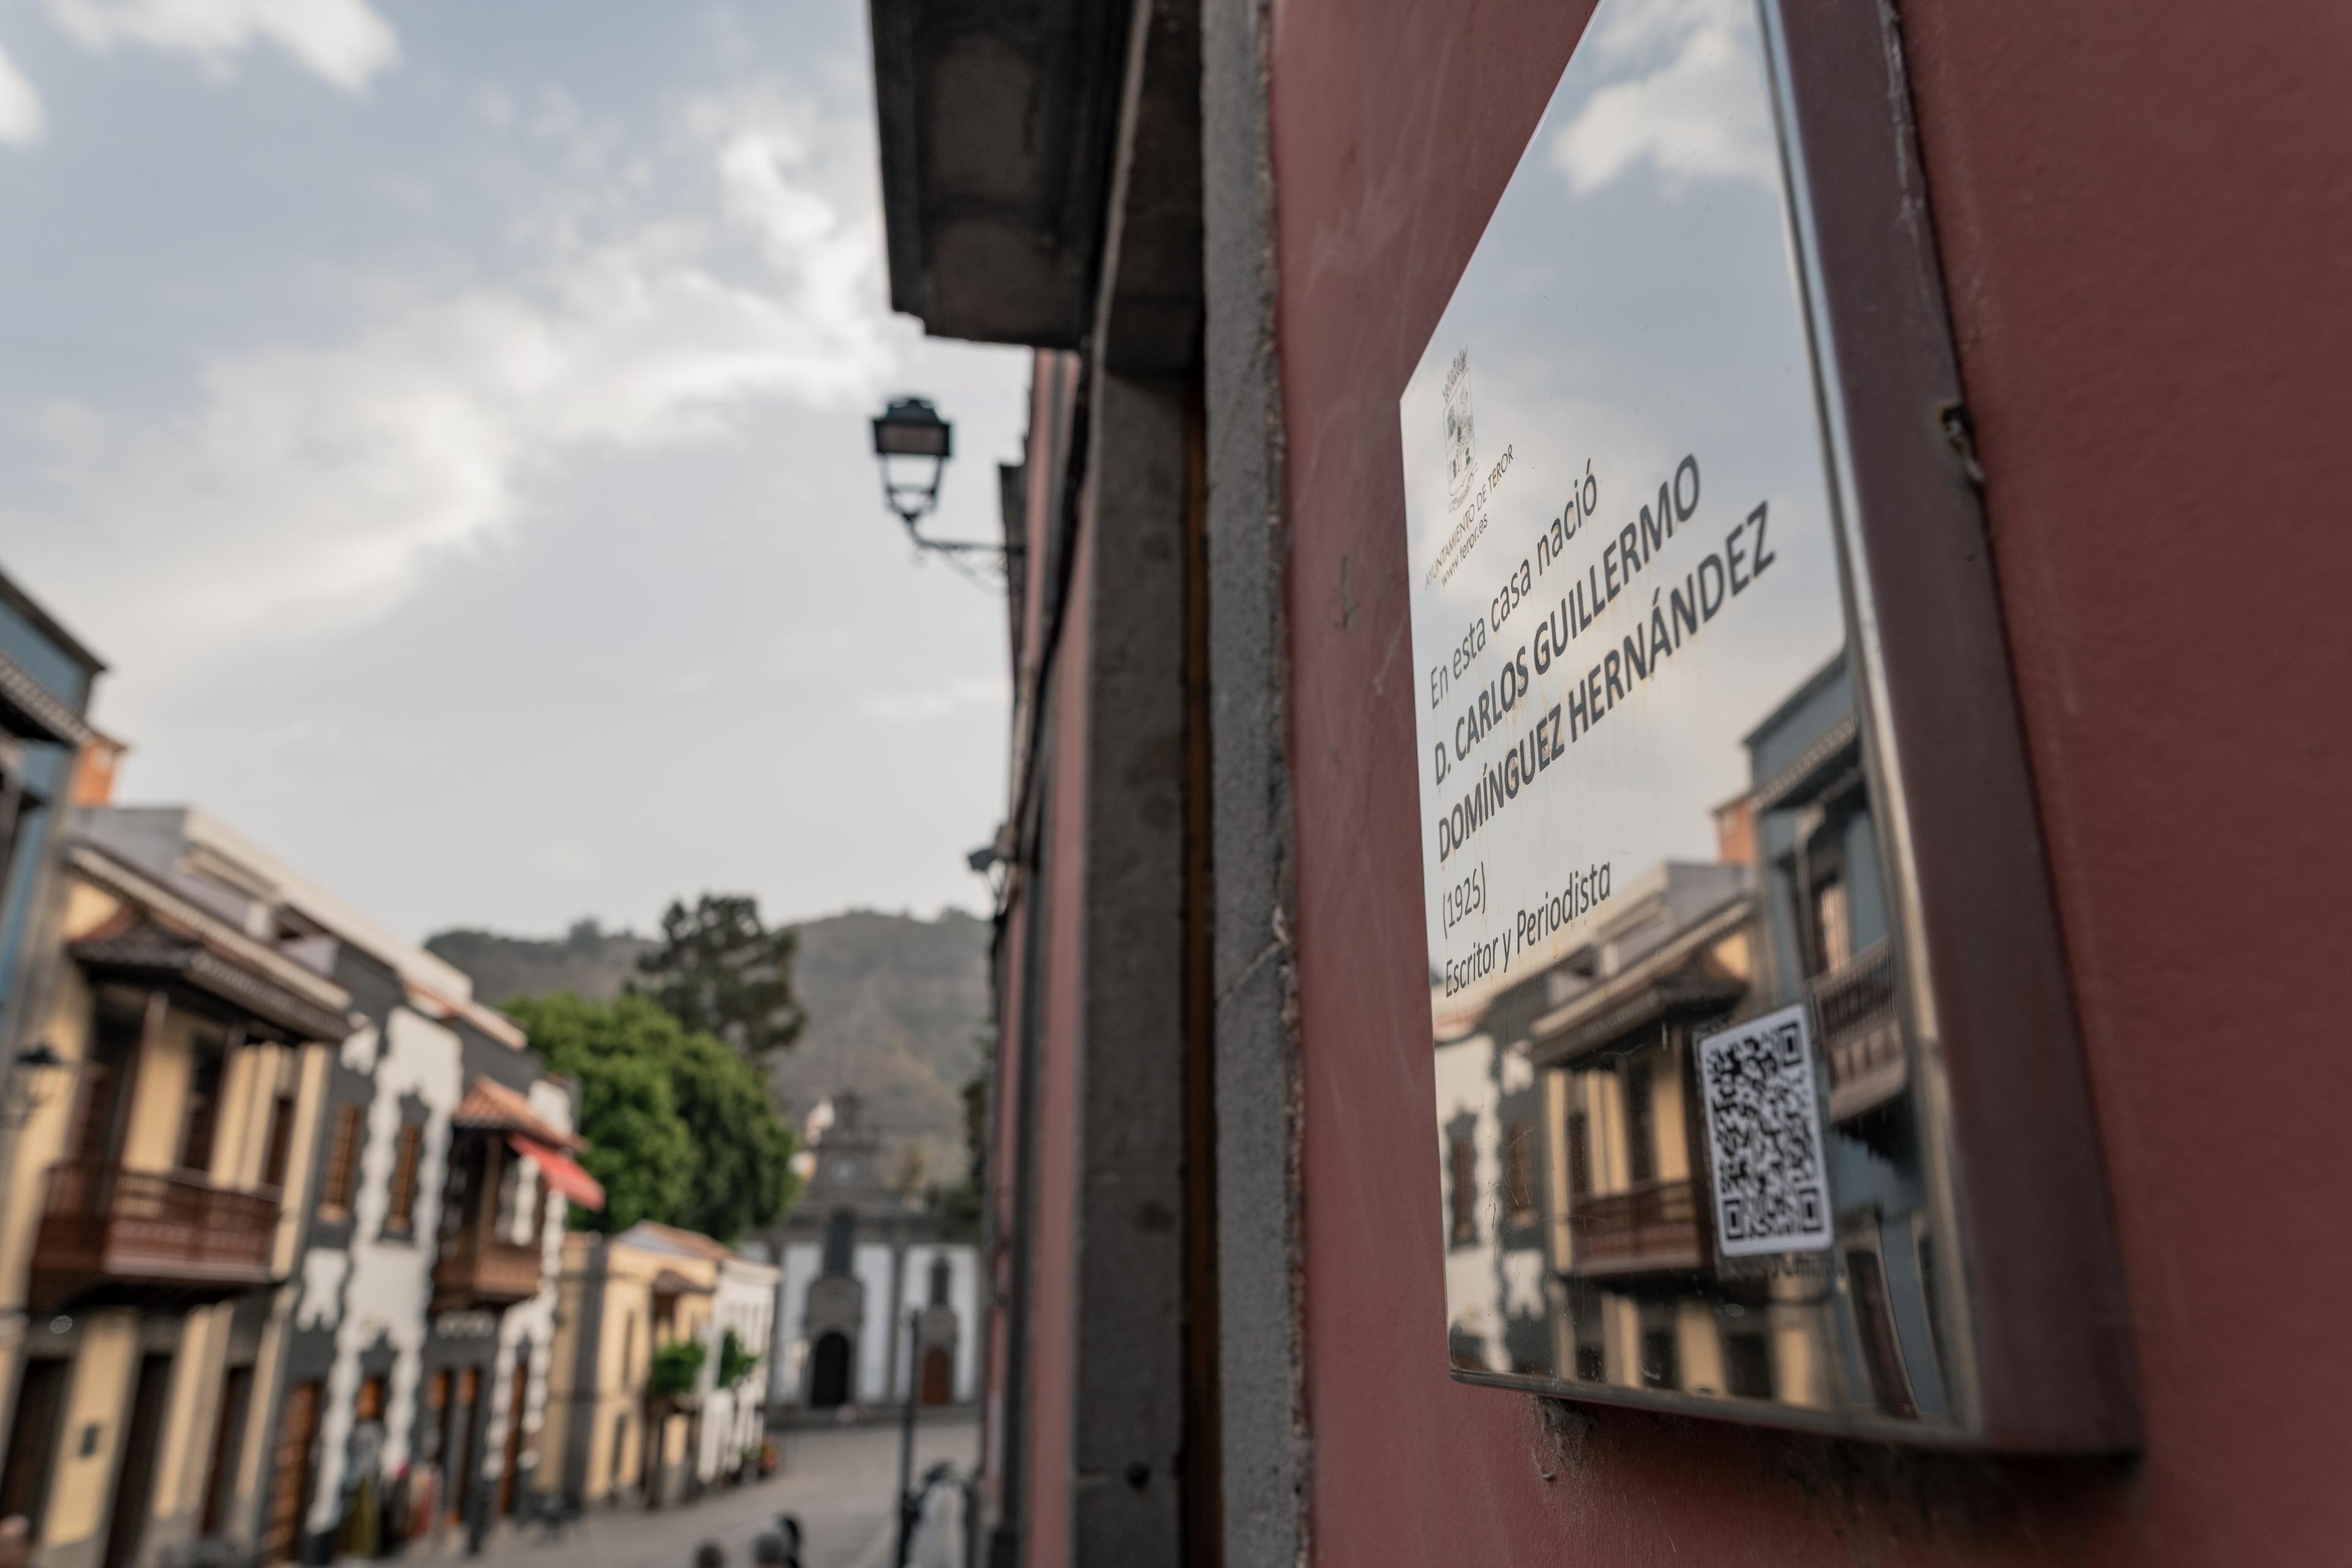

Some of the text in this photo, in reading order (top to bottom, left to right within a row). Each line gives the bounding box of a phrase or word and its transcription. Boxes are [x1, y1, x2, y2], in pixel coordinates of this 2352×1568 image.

[1425, 503, 1475, 590] AYUNTAMIENTO
[1476, 483, 1488, 512] DE
[1487, 444, 1513, 494] TEROR
[1431, 458, 1597, 710] En esta casa nació
[1441, 513, 1488, 587] wwwteror.es
[1435, 453, 1700, 786] D. CARLOS GUILLERMO
[1438, 500, 1776, 864] DOMÍNGUEZ HERNÁNDEZ
[1442, 861, 1486, 940] (1925)
[1446, 861, 1611, 998] Escritor y Periodista
